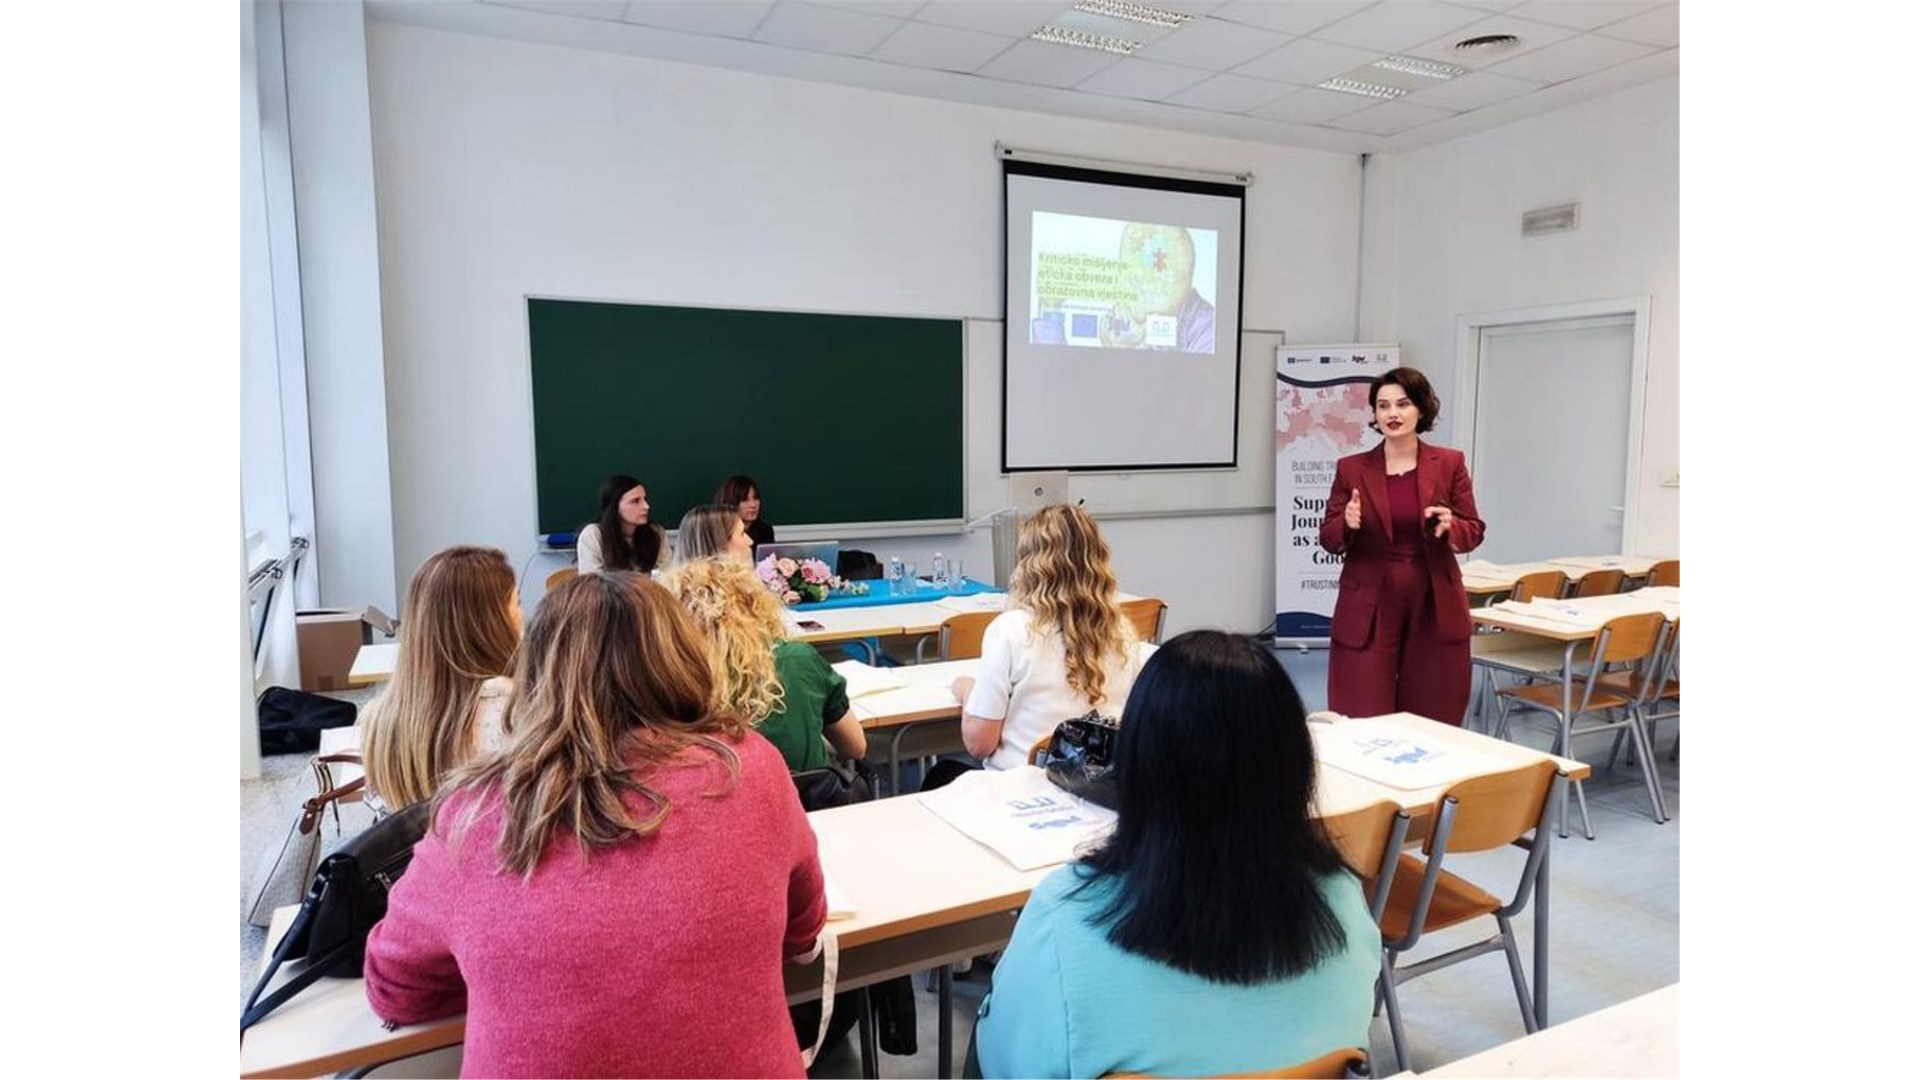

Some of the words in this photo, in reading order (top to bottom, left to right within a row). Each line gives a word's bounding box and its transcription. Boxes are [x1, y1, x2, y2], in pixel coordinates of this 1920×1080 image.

[1291, 460, 1325, 471] BUILDING
[1295, 473, 1302, 484] IN
[1303, 473, 1327, 484] SOUTH
[1293, 495, 1328, 513] Sup
[1293, 535, 1310, 547] as
[1312, 550, 1346, 565] Goo
[1301, 579, 1340, 590] #TRUSTIN
